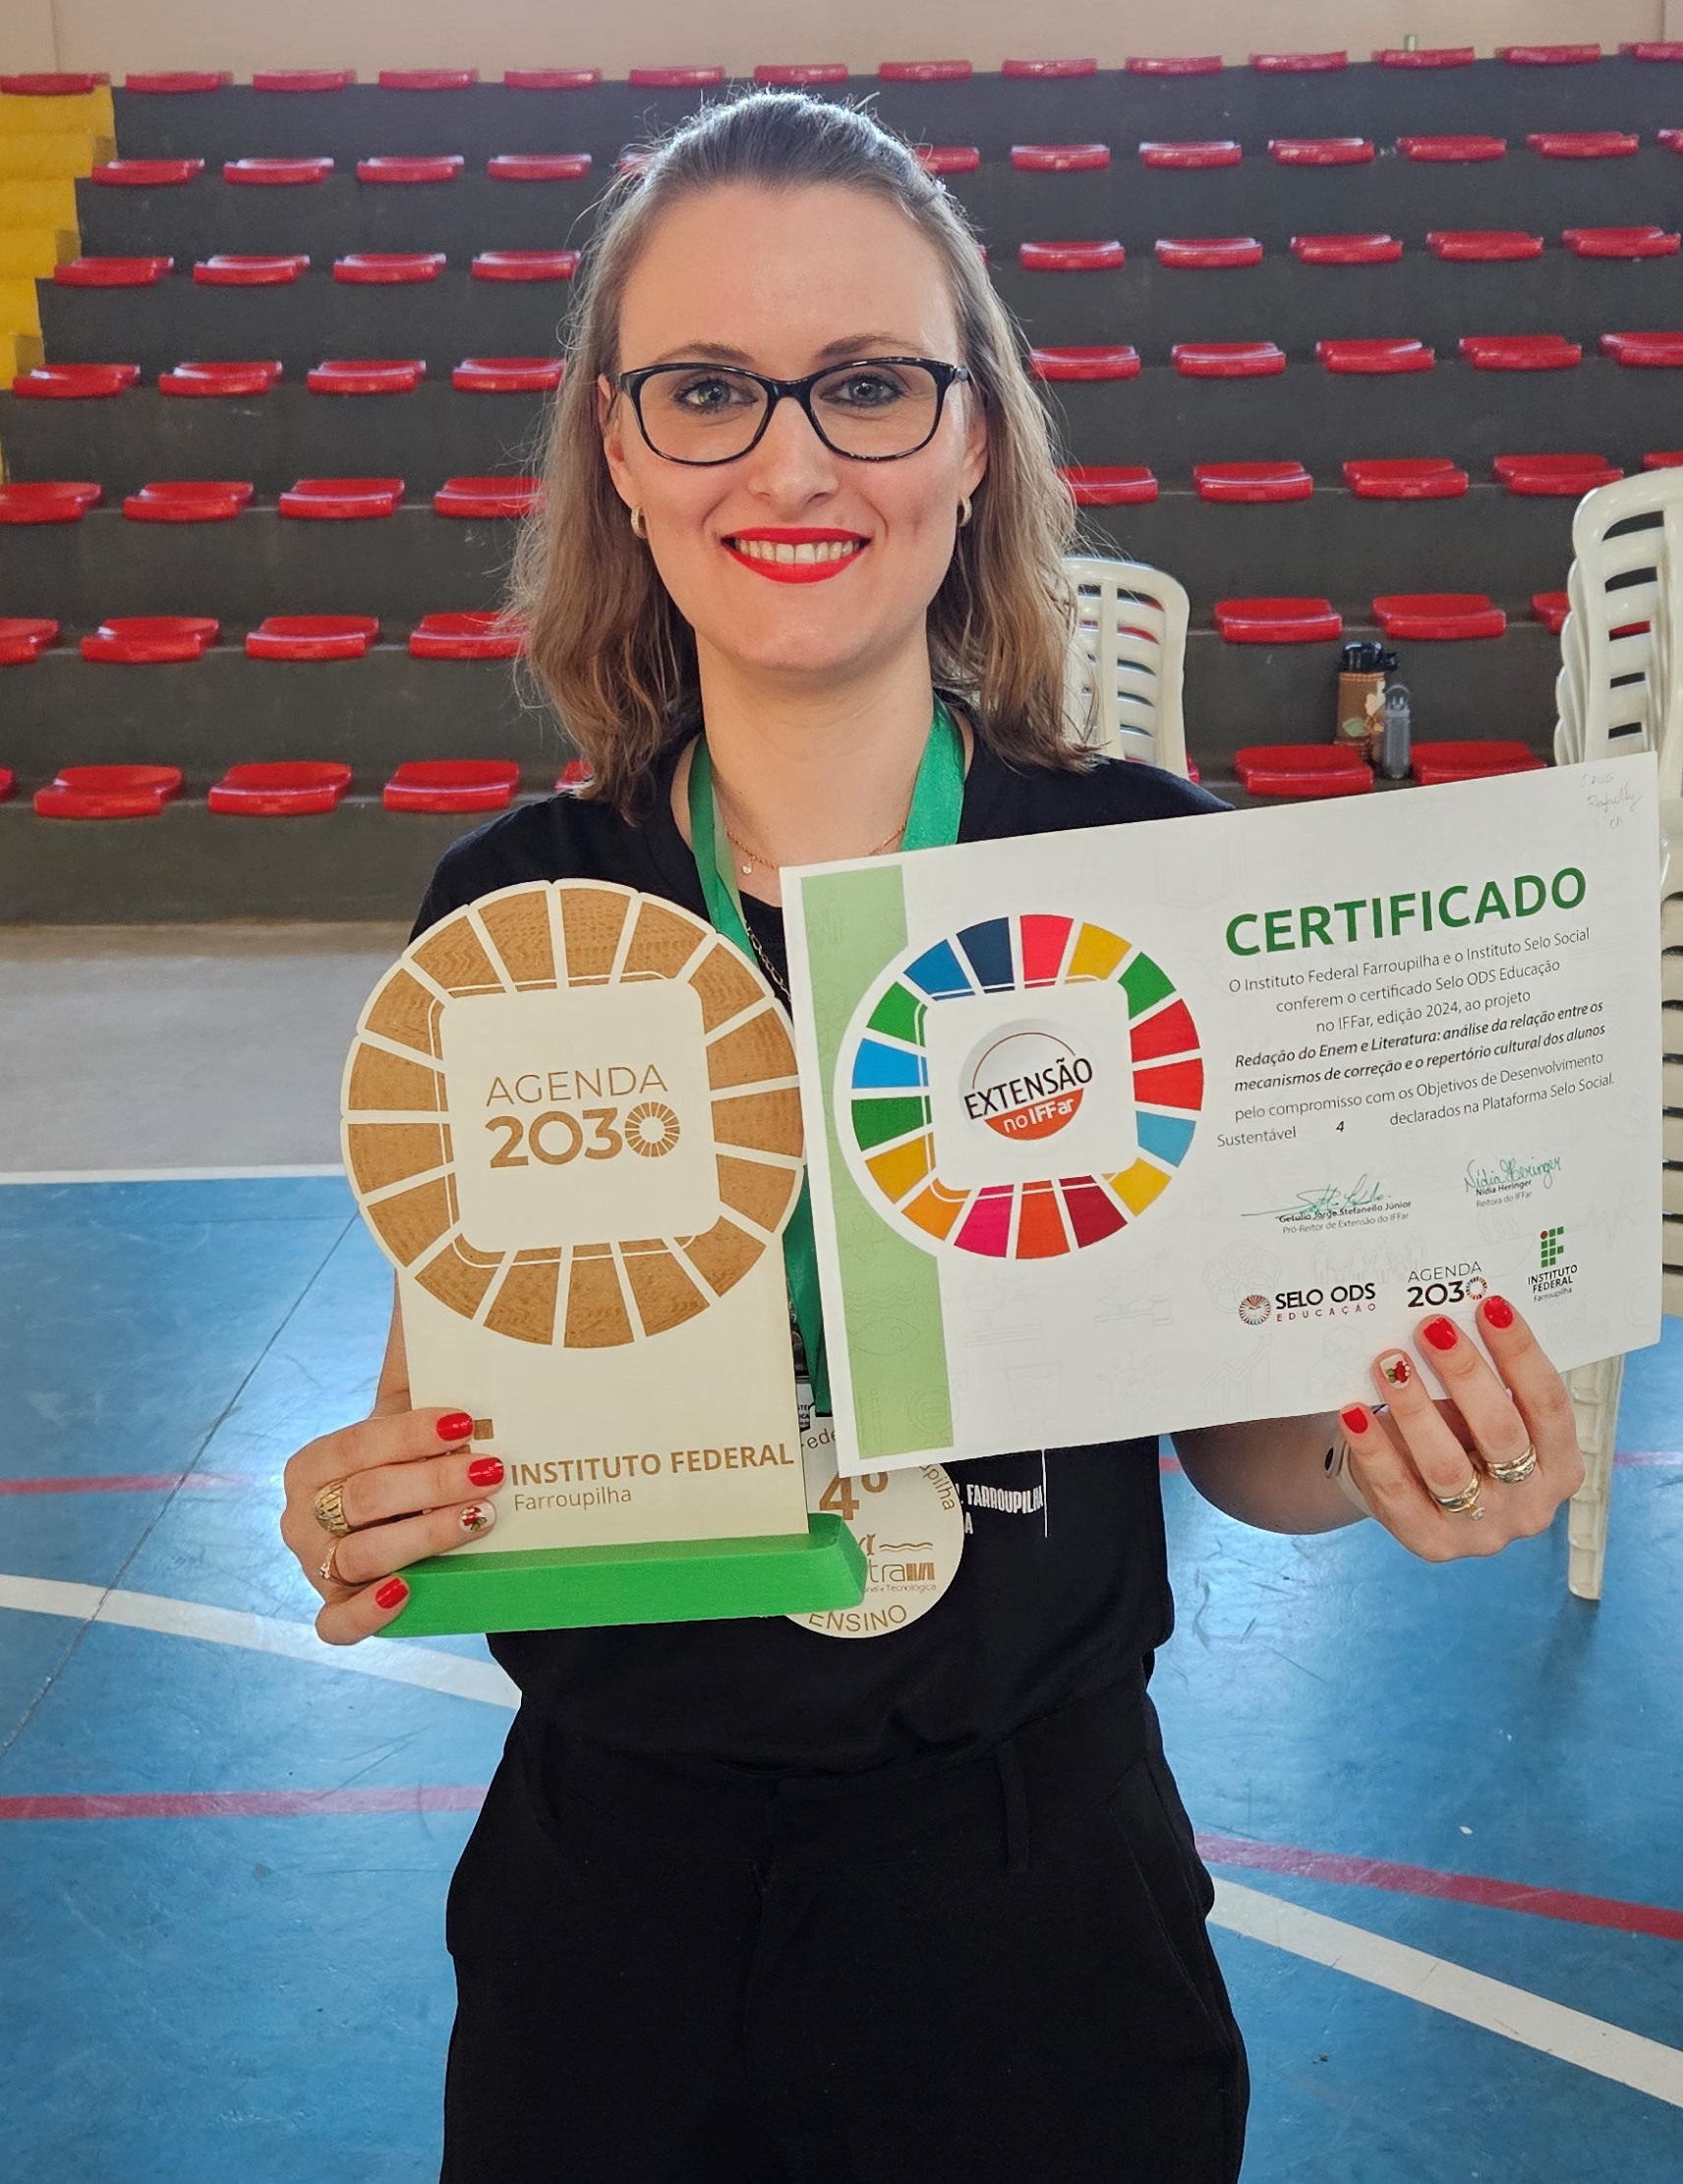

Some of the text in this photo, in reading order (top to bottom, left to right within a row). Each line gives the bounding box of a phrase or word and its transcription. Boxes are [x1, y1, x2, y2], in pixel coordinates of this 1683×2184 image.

[1226, 866, 1587, 956] CERTIFICADO
[1229, 927, 1590, 992] O Instituto Federal Farroupilha e o Instituto Selo Social
[1276, 960, 1560, 1013] conferem o certificado Selo ODS Educação
[1316, 991, 1531, 1033] no IFFar, edição 2024, ao projeto
[1235, 1001, 1603, 1068] Redação do Enem e Literatura: análise da relação entre os
[1235, 1025, 1605, 1092] mecanismos de correção e o repertório cultural dos alunos
[486, 1063, 668, 1107] AGENDA
[963, 1057, 1093, 1120] EXTENSÃO
[1235, 1053, 1603, 1123] pelo compromisso com os Objetivos de Desenvolvimento
[1003, 1097, 1074, 1133] no IFFar
[1217, 1072, 1615, 1148] Sustentável 4 declarados na Plataforma Selo Social.
[1498, 1180, 1532, 1193] Heringer
[1326, 1219, 1337, 1229] de
[1378, 1214, 1388, 1224] do
[1407, 1261, 1482, 1283] AGENDA
[1528, 1264, 1578, 1285] INSTITUTO
[1533, 1274, 1574, 1294] FEDERAL
[1275, 1282, 1376, 1310] SELO ODS
[1534, 1287, 1572, 1303] Farroupilha
[511, 1443, 794, 1486] INSTITUTO FEDERAL
[514, 1486, 632, 1511] Farroupilha
[966, 1484, 1043, 1514] FARROUPILHA
[808, 1605, 906, 1632] ENSINO
